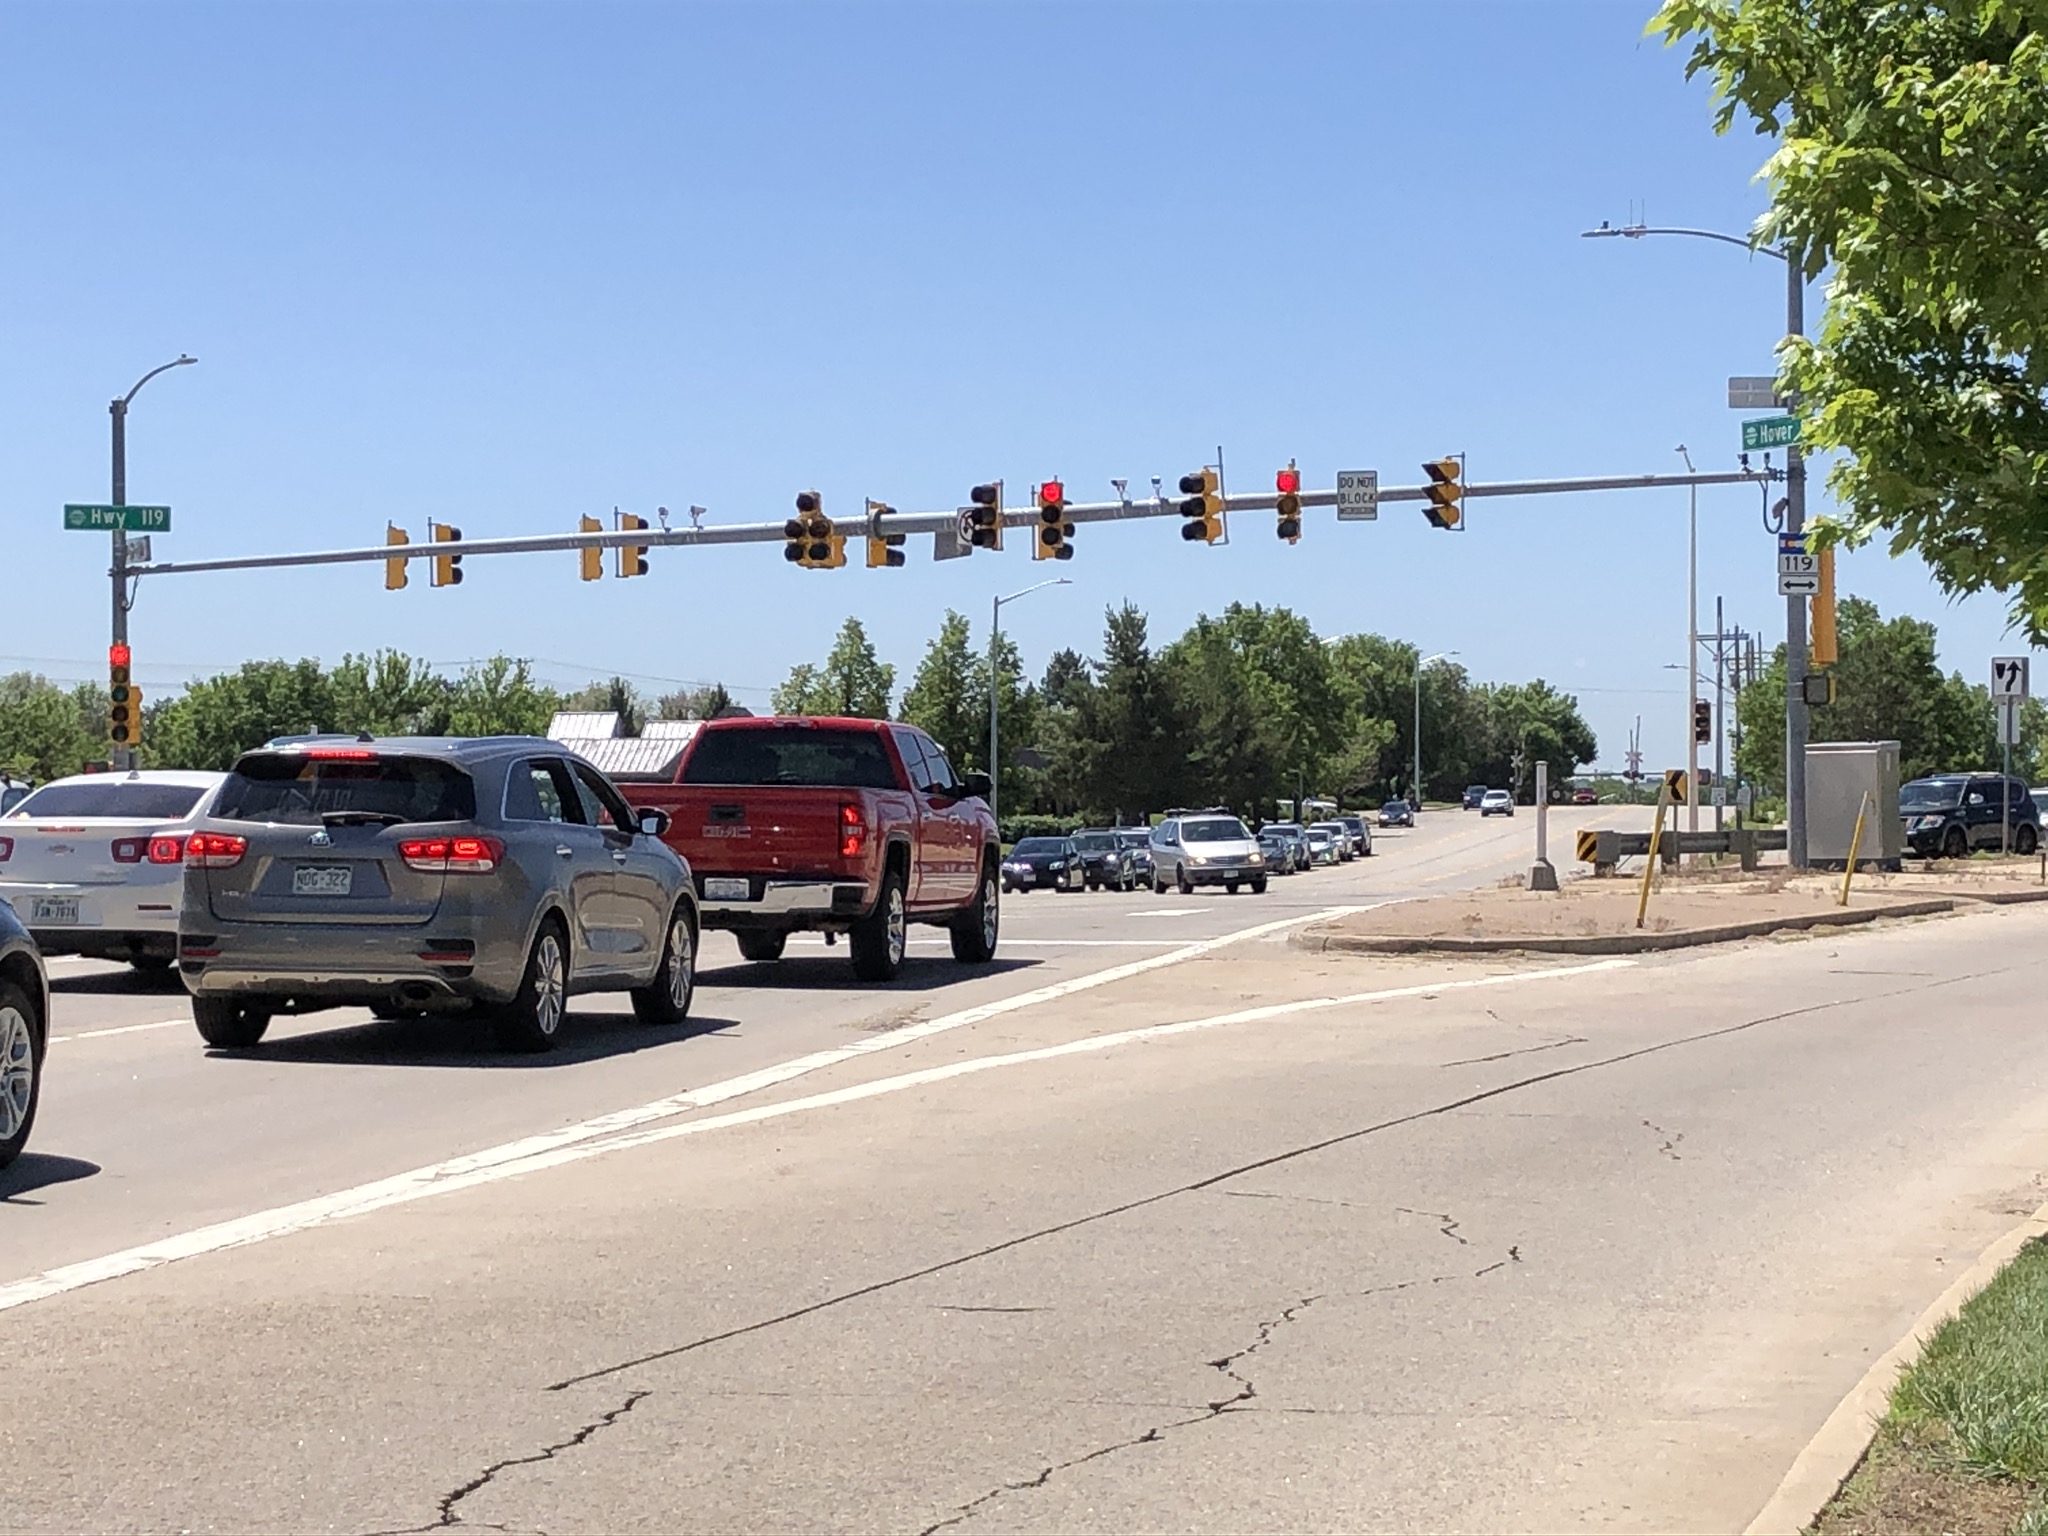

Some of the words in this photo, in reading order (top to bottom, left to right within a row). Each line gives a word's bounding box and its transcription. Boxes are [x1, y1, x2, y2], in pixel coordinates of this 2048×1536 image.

[1760, 424, 1793, 443] Hover
[1340, 477, 1354, 488] DO
[1357, 477, 1375, 488] NOT
[1340, 492, 1376, 504] BLOCK
[91, 508, 126, 529] Hwy
[142, 509, 164, 525] 119
[1785, 556, 1813, 571] 119
[702, 825, 751, 838] GMC
